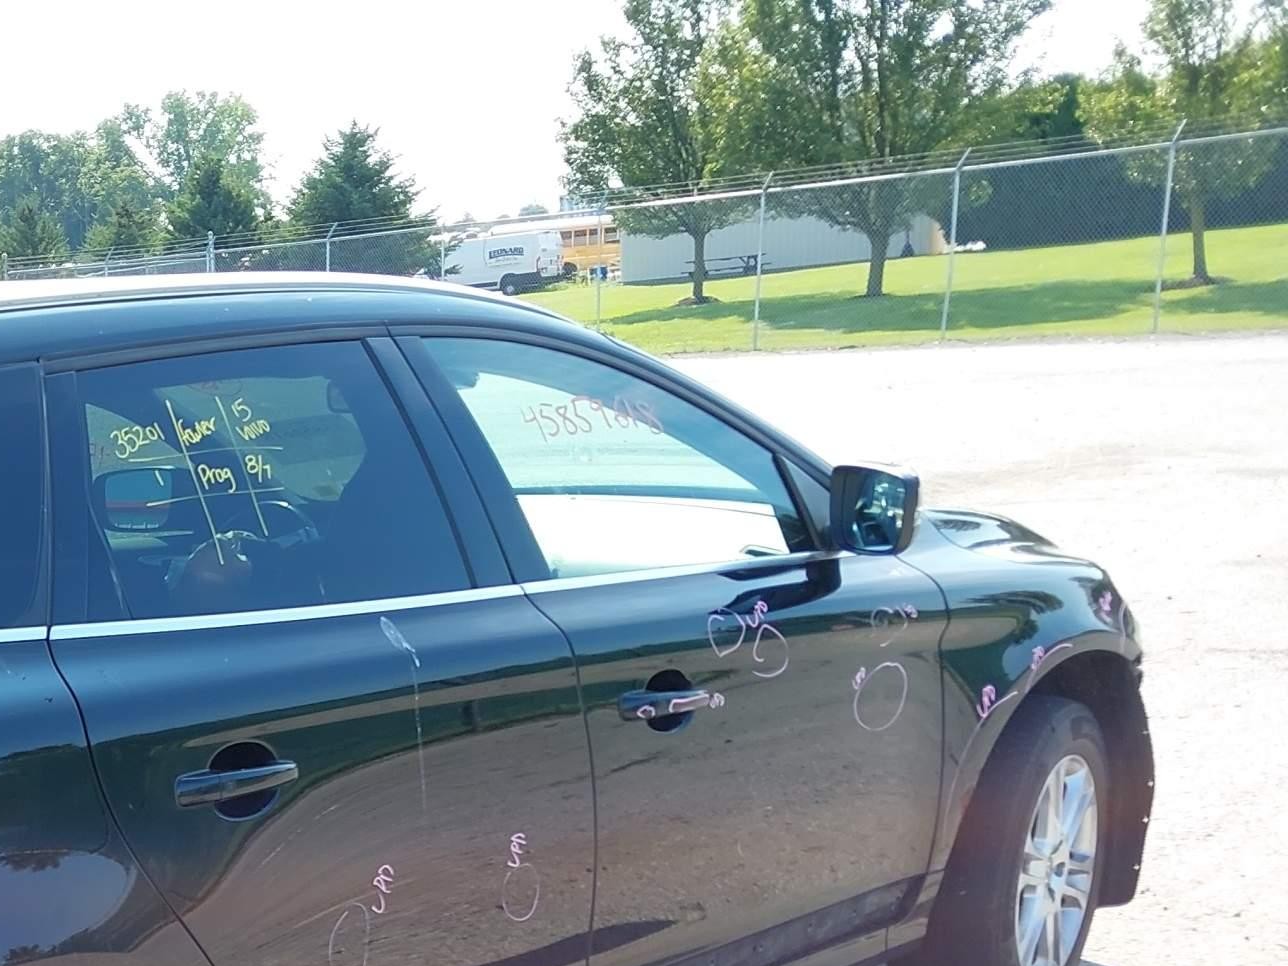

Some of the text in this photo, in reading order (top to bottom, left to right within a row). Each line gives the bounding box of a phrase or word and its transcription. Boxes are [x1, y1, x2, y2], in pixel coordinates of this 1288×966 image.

[231, 397, 252, 422] 15
[110, 422, 165, 459] 35201
[197, 463, 237, 493] Prog
[244, 454, 272, 483] 8/7
